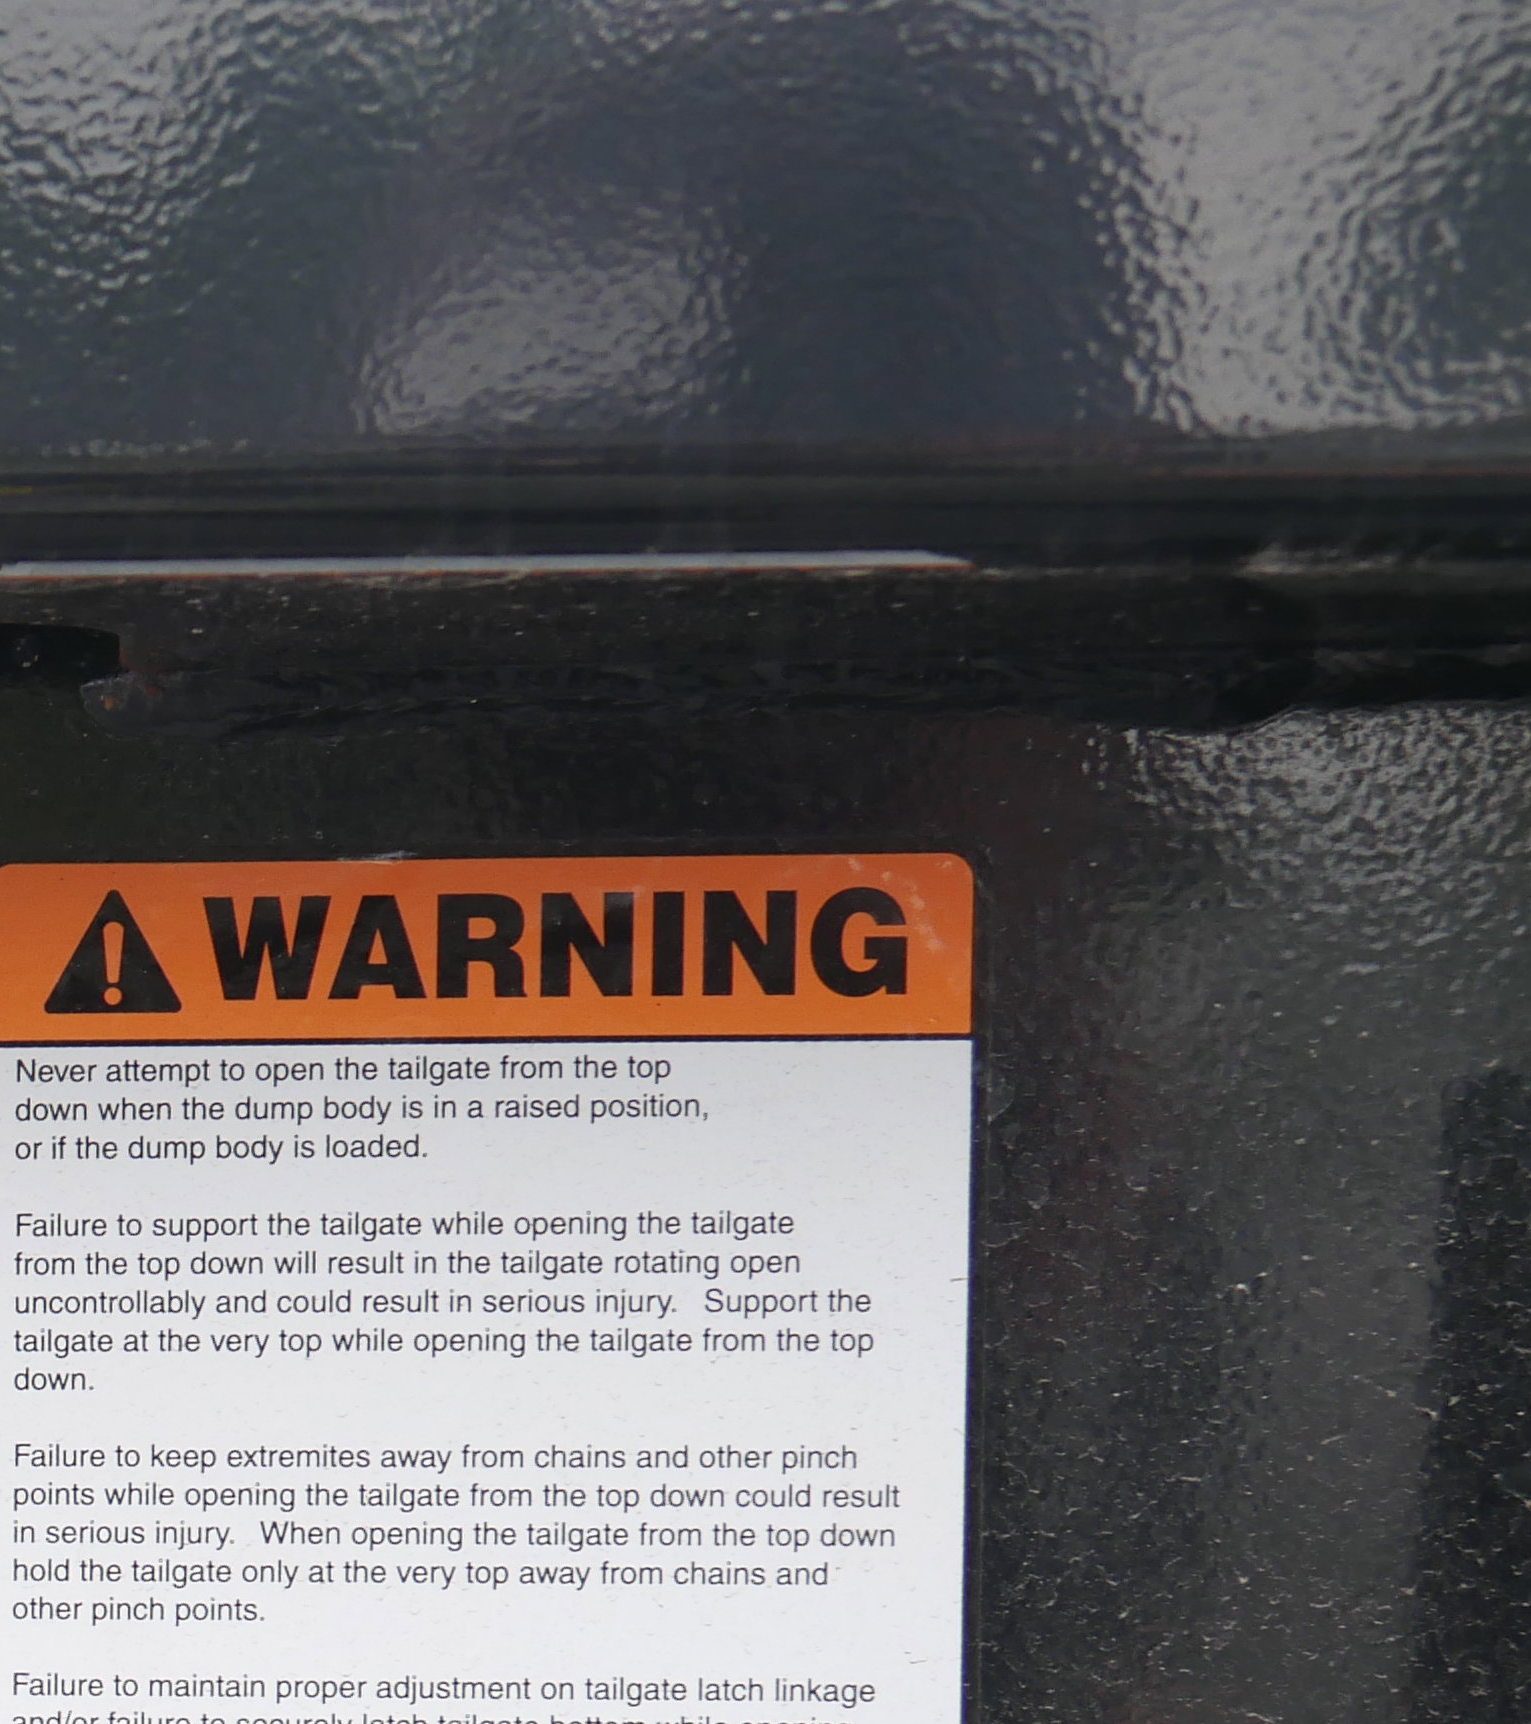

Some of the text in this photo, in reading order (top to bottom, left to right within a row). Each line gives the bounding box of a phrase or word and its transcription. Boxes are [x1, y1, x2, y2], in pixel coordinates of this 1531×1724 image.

[203, 887, 907, 1000] WARNING
[17, 1055, 671, 1088] Never attempt to open the tailgate from the top
[15, 1094, 707, 1126] down when the dump body is in a raised position,
[16, 1211, 794, 1242] Failure to support the tailgate while opening the tailgate
[16, 1288, 871, 1320] uncontrollably and could result in serious injury. Support the
[14, 1367, 93, 1390] down.
[15, 1444, 856, 1474] Failure to keep extremites away from chains and other pinch
[13, 1596, 264, 1627] other pinch points.
[13, 1673, 875, 1709] Failure to maintain proper adjustment on tailgate latch linkage
